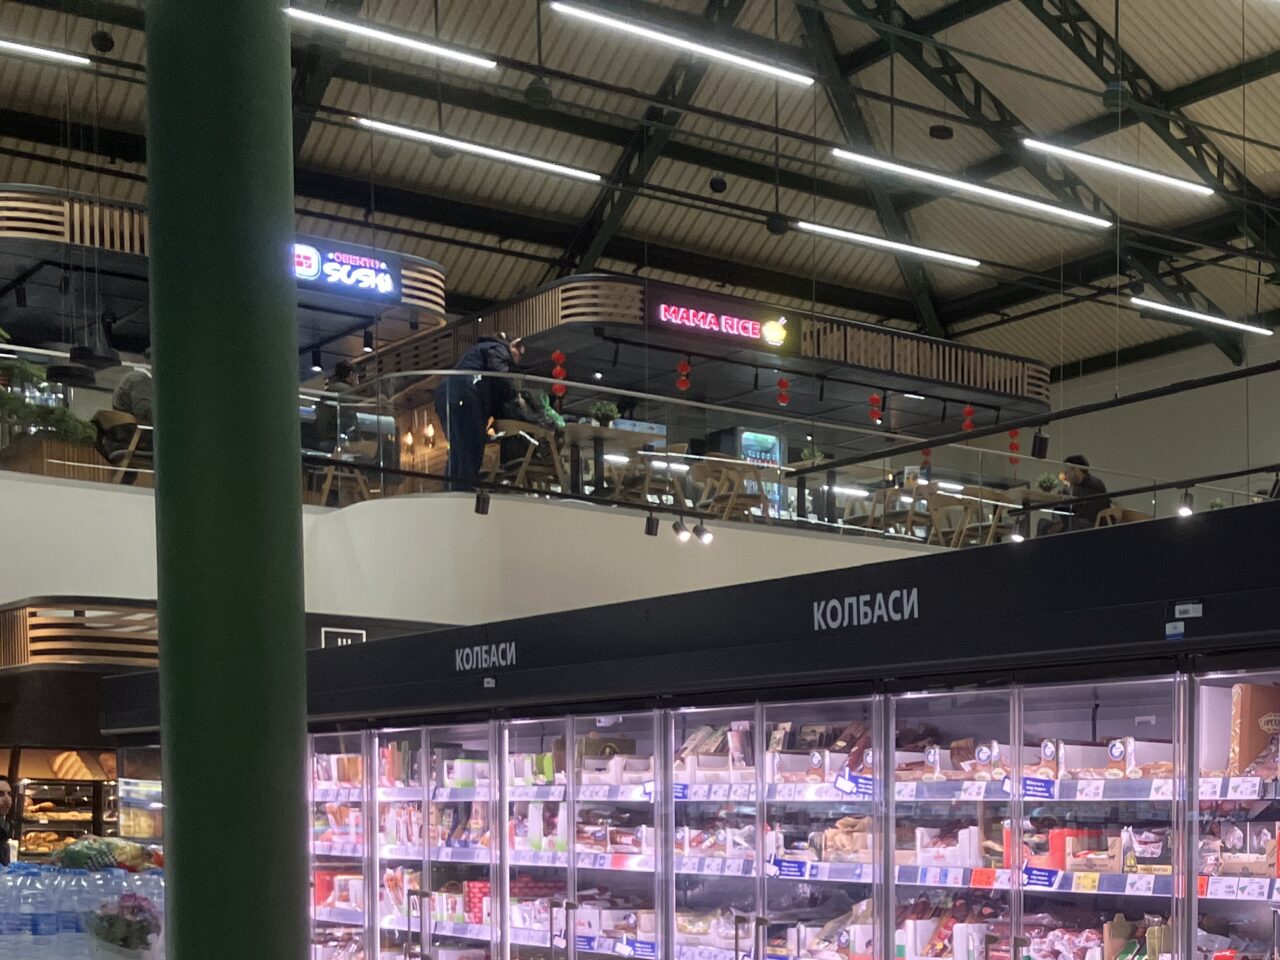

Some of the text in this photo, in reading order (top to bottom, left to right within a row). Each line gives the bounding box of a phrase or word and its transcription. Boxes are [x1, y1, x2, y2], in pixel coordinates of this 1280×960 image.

[659, 304, 761, 339] MAMA RICE
[813, 587, 919, 631] КОЛБАСИ
[455, 641, 516, 672] КОЛБАСИ
